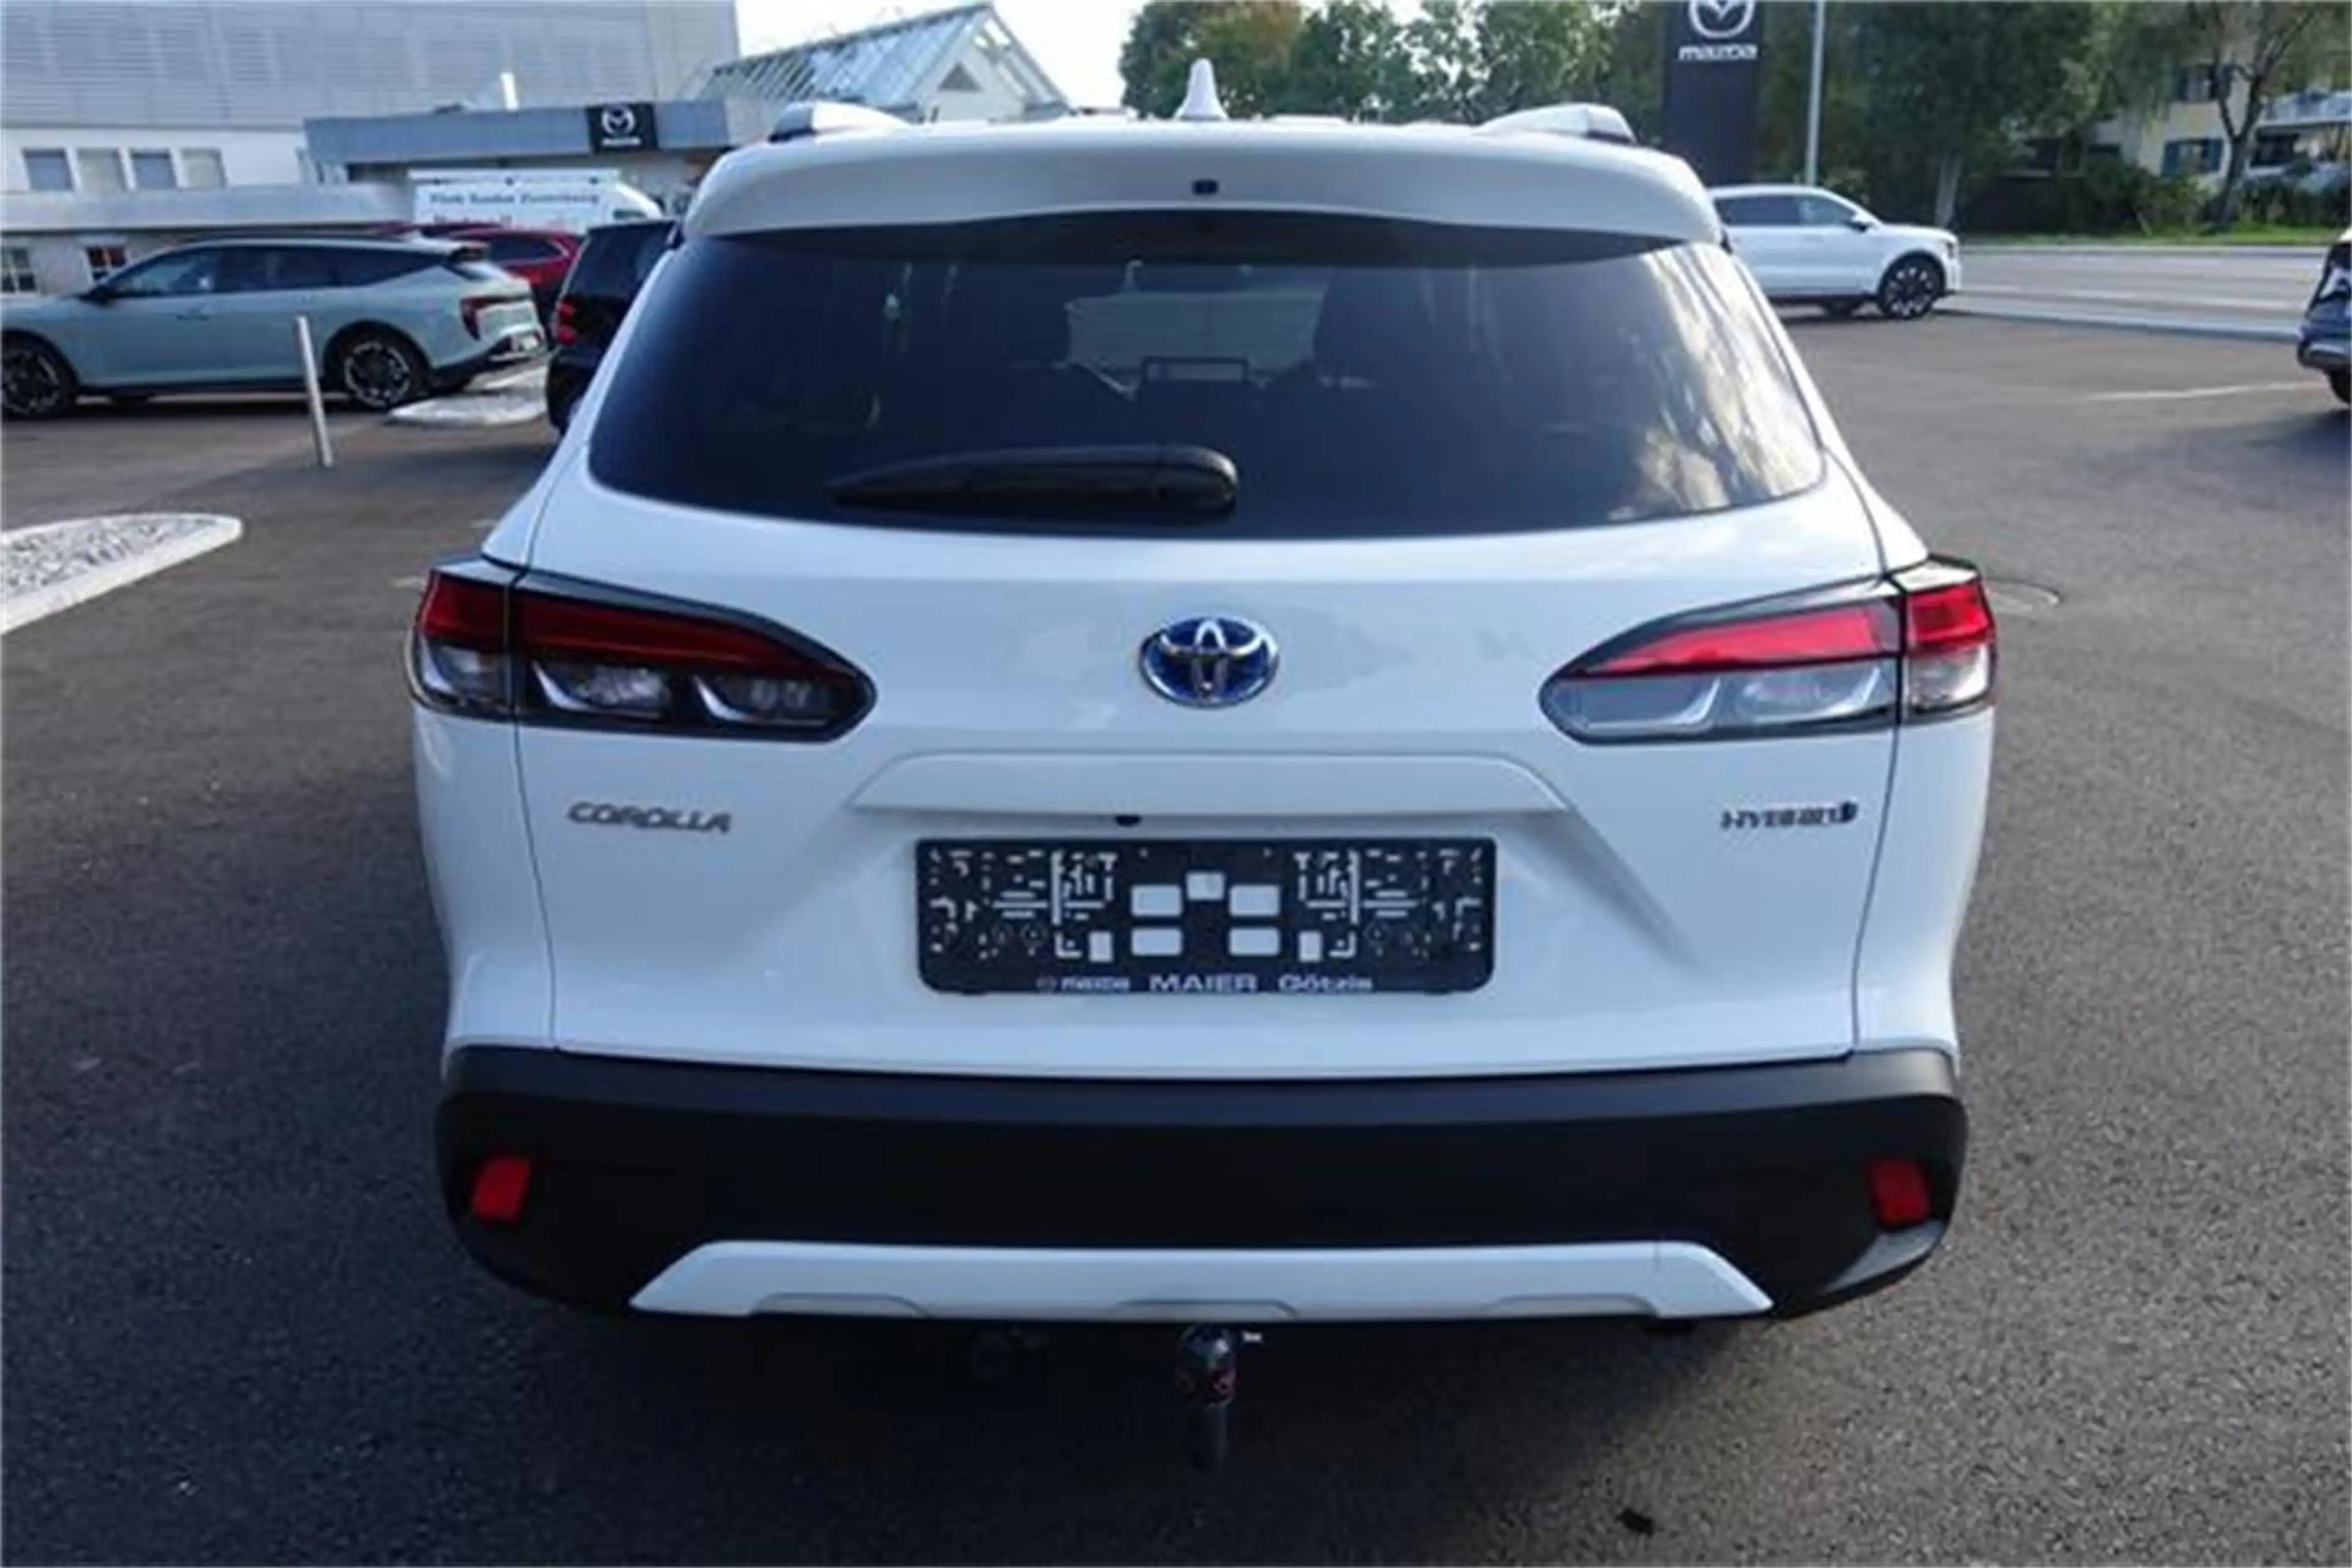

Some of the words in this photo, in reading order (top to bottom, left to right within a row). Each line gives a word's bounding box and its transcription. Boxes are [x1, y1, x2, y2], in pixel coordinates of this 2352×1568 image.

[1678, 44, 1757, 60] mazda
[567, 801, 731, 833] COROLLA
[1150, 974, 1257, 992] MAIER
